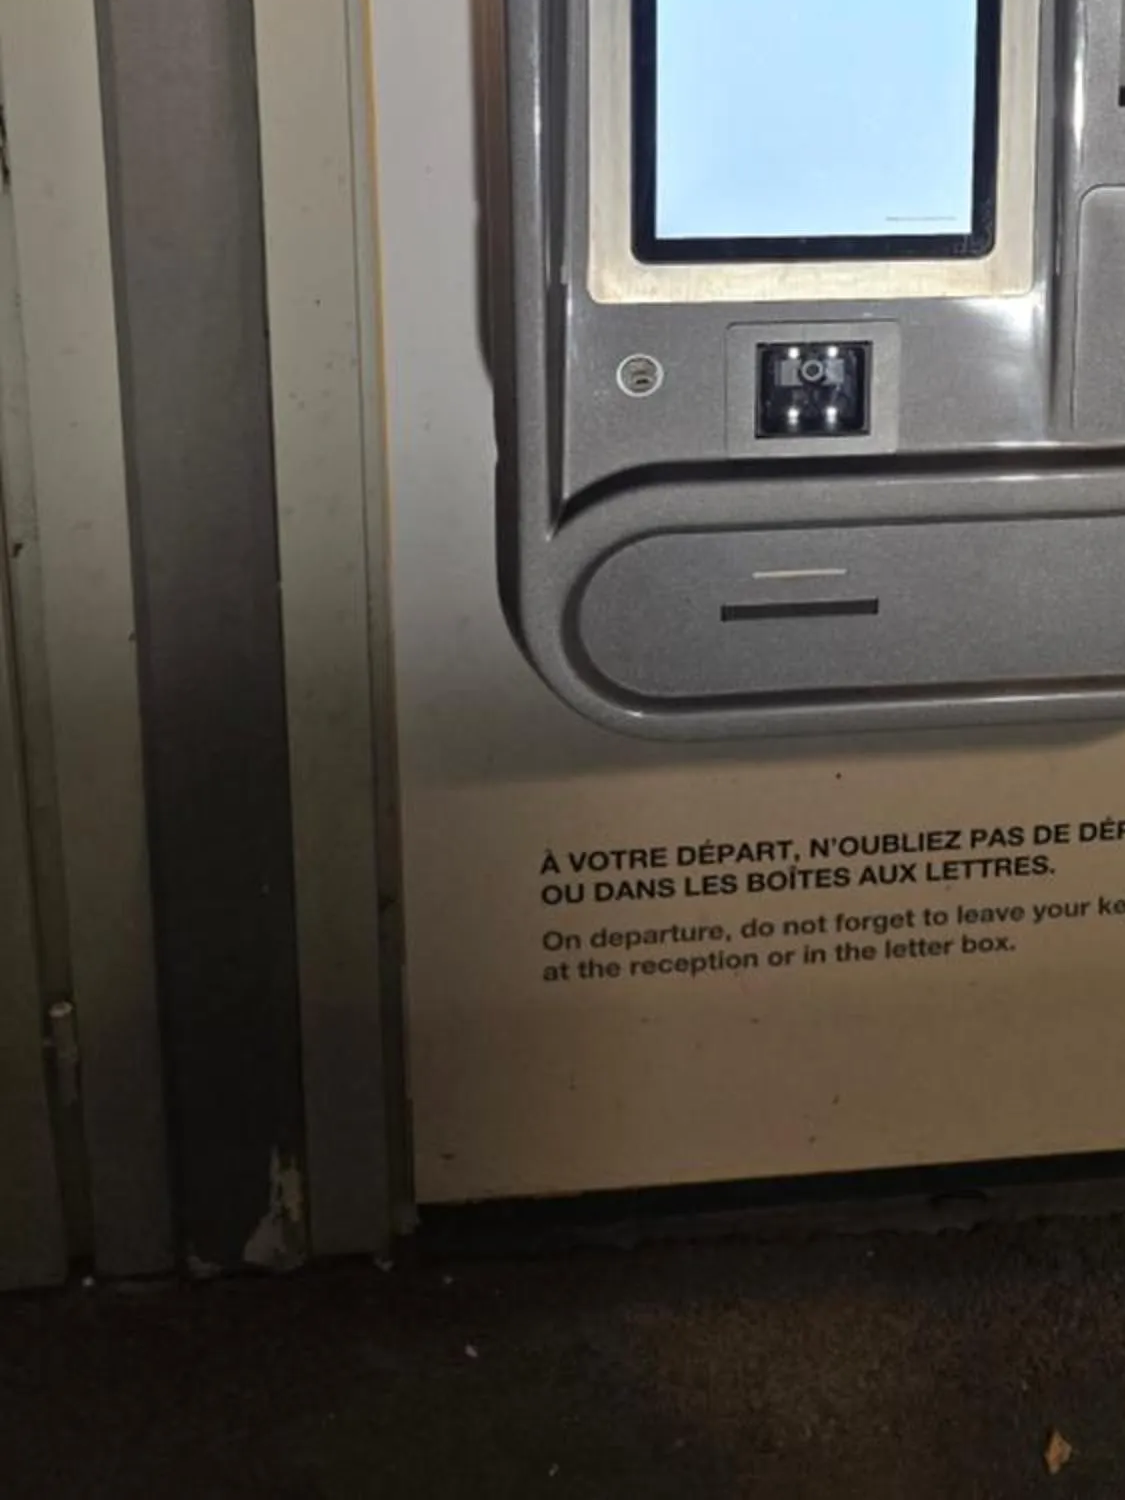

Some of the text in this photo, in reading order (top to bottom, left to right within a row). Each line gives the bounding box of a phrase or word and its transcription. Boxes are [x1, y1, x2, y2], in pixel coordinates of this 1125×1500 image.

[540, 849, 561, 875] À
[569, 847, 667, 873] VOTRE
[677, 838, 800, 868] DÉPART,
[809, 830, 961, 859] N'OUBLIEZ
[971, 825, 1024, 849] PAS
[1033, 824, 1070, 846] DE
[541, 855, 1055, 906] OU DANS LES BOÎTES AUX LETTRES.
[543, 930, 582, 951] On
[590, 922, 732, 956] departure,
[740, 917, 775, 938] do
[783, 915, 828, 936] not
[836, 908, 915, 936] forget
[923, 908, 948, 928] to
[957, 903, 1025, 926] leave
[1033, 901, 1089, 924] your
[543, 934, 1016, 982] at the reception or in the letter box.
